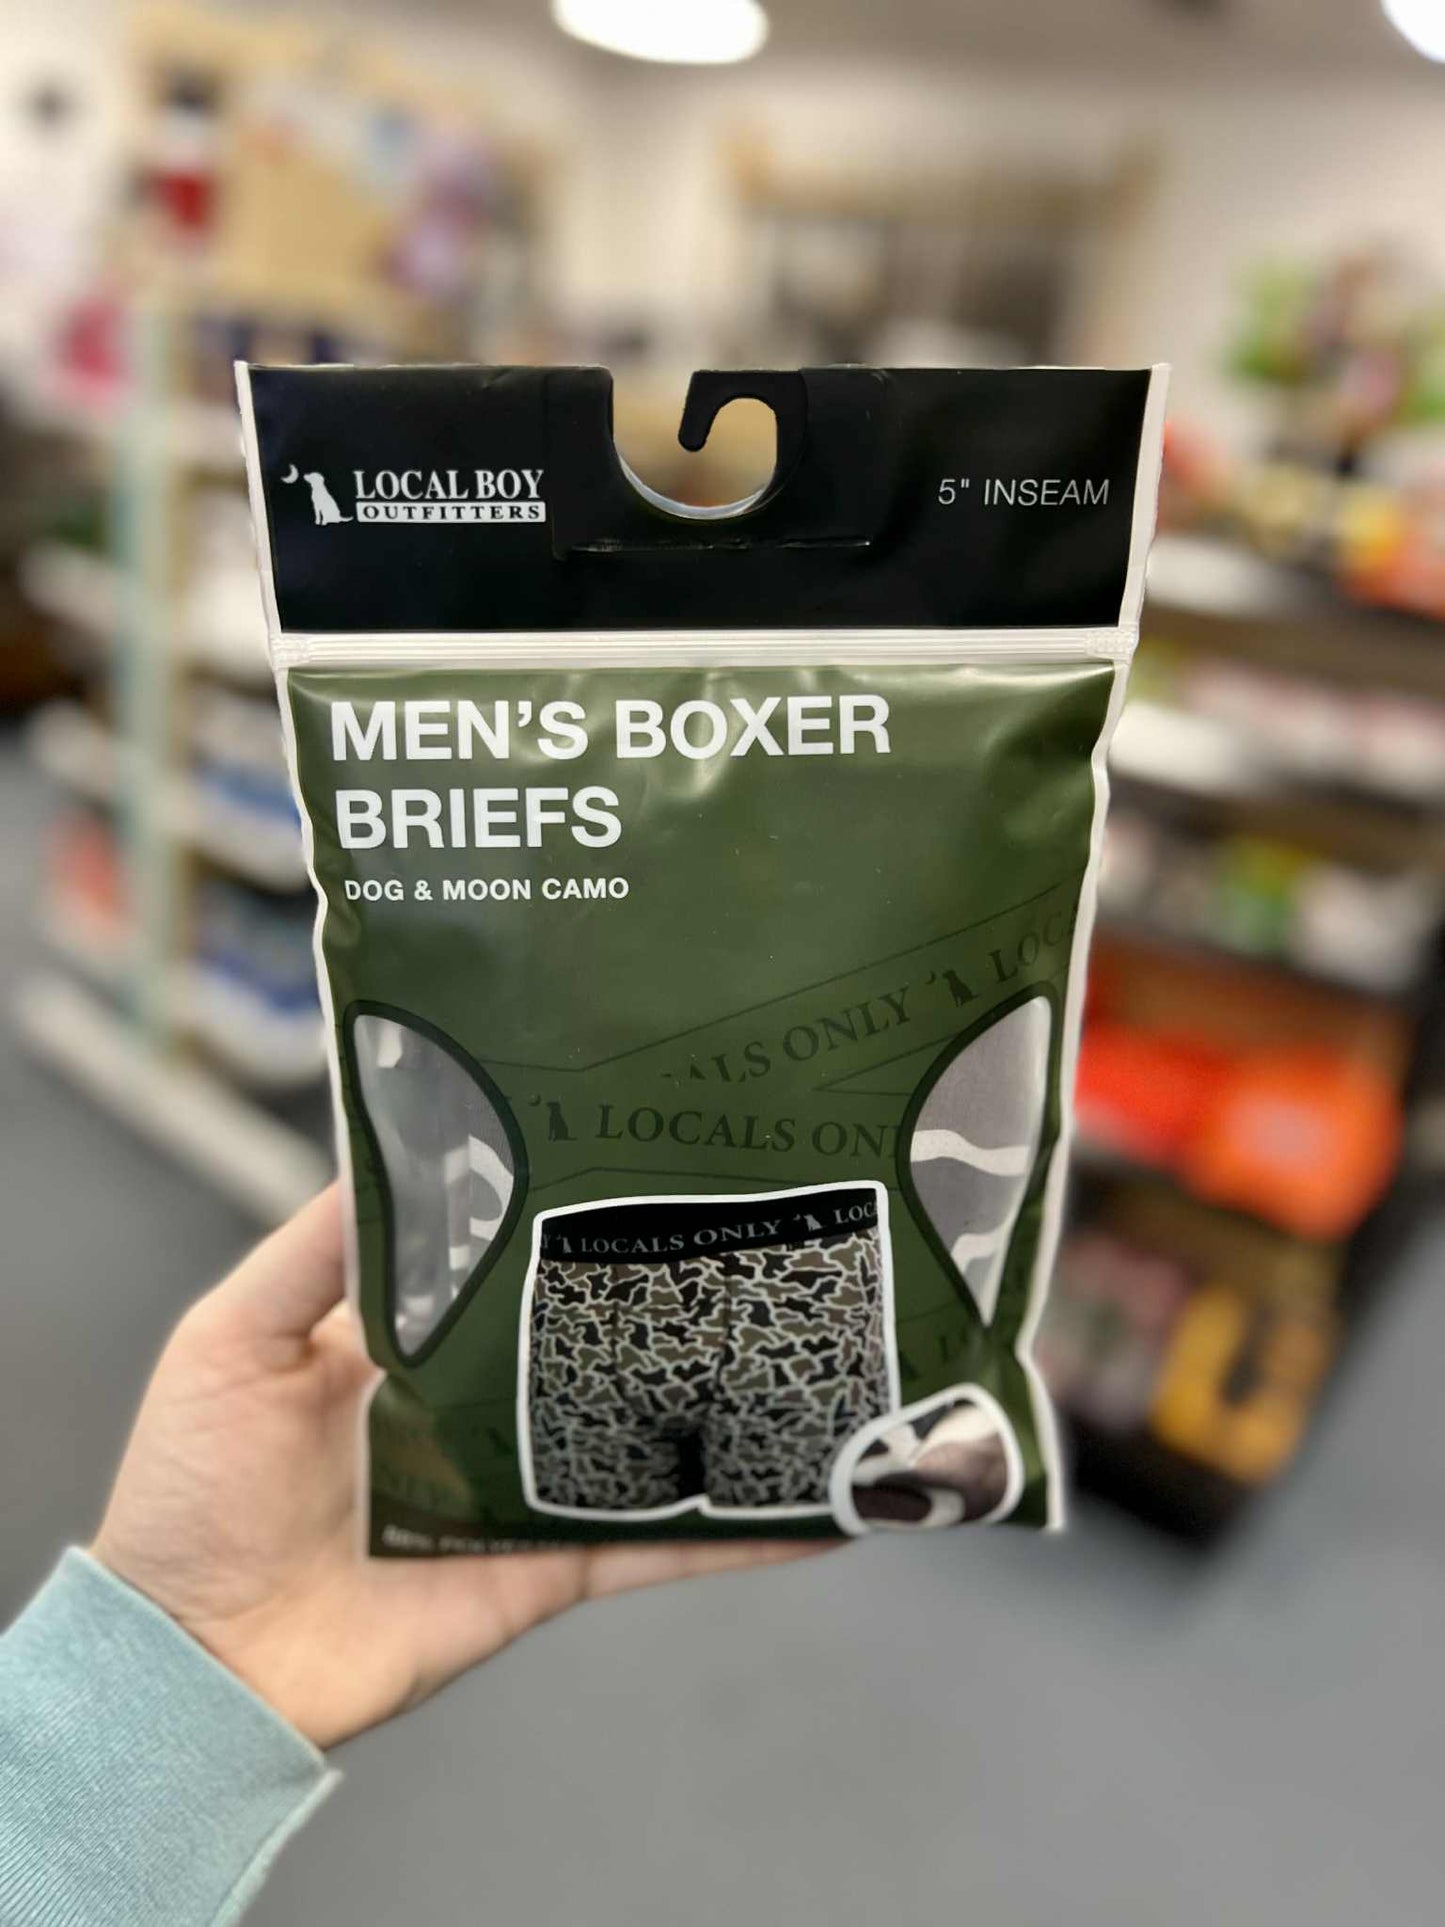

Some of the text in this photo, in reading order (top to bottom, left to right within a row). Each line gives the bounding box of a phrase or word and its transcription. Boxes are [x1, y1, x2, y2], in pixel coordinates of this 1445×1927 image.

[353, 469, 544, 500] LOCAL BOY
[938, 478, 1110, 506] 5" INSEAM
[363, 505, 541, 520] OUTFITTERS
[330, 694, 892, 761] MEN’S BOXER
[335, 786, 622, 849] BRIEFS
[345, 877, 630, 901] DOG & MOON CAMO
[783, 986, 911, 1061] ONLY
[988, 906, 1075, 984] LOC
[595, 1103, 797, 1152] LOCALS
[581, 1234, 685, 1254] LOCALS
[693, 1218, 782, 1246] ONLY
